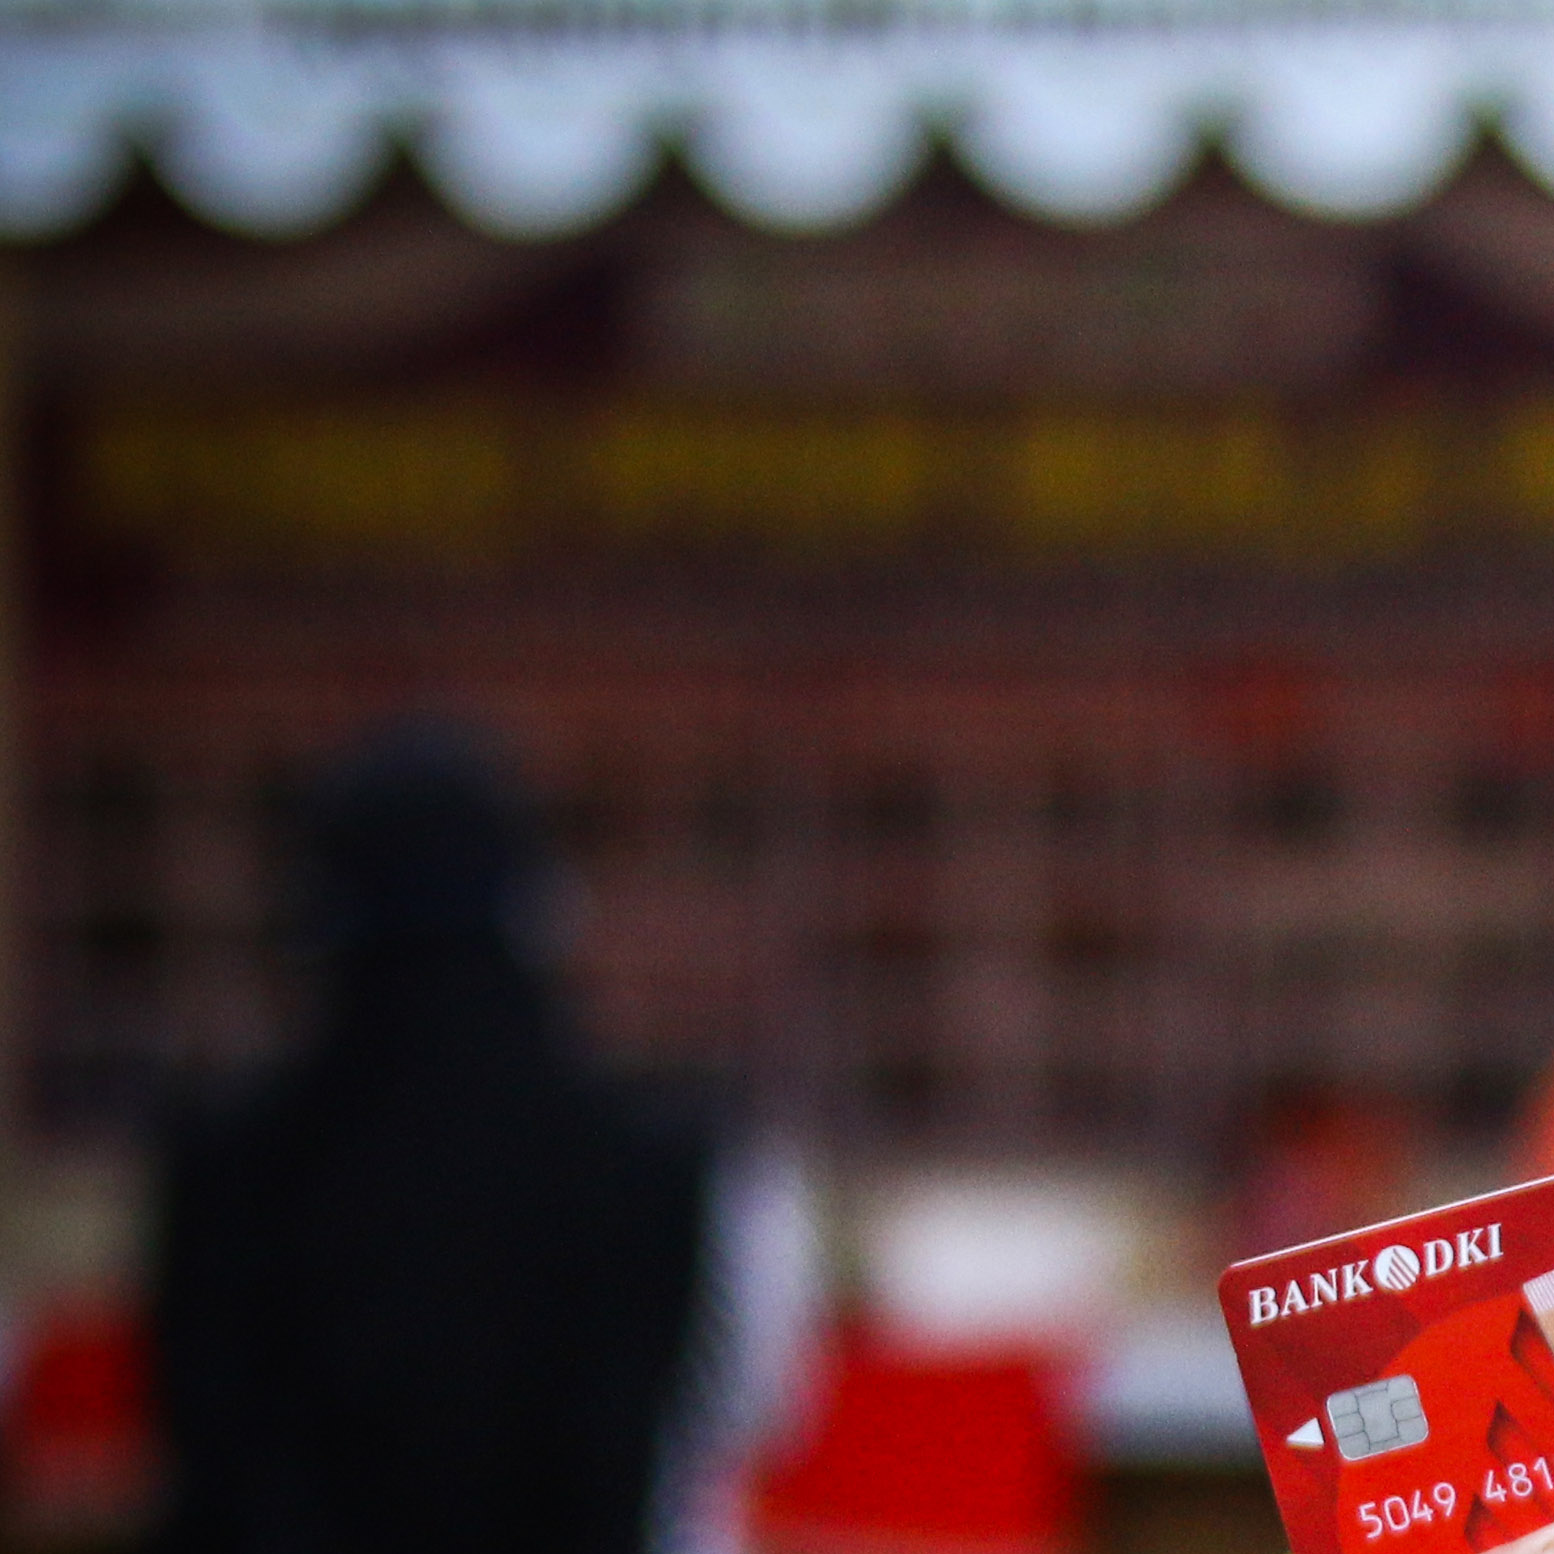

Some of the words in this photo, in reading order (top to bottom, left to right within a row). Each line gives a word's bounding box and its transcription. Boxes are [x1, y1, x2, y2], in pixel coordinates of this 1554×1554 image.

[1247, 1260, 1374, 1325] BANK
[1422, 1223, 1505, 1279] DKI
[1358, 1482, 1457, 1541] 5049
